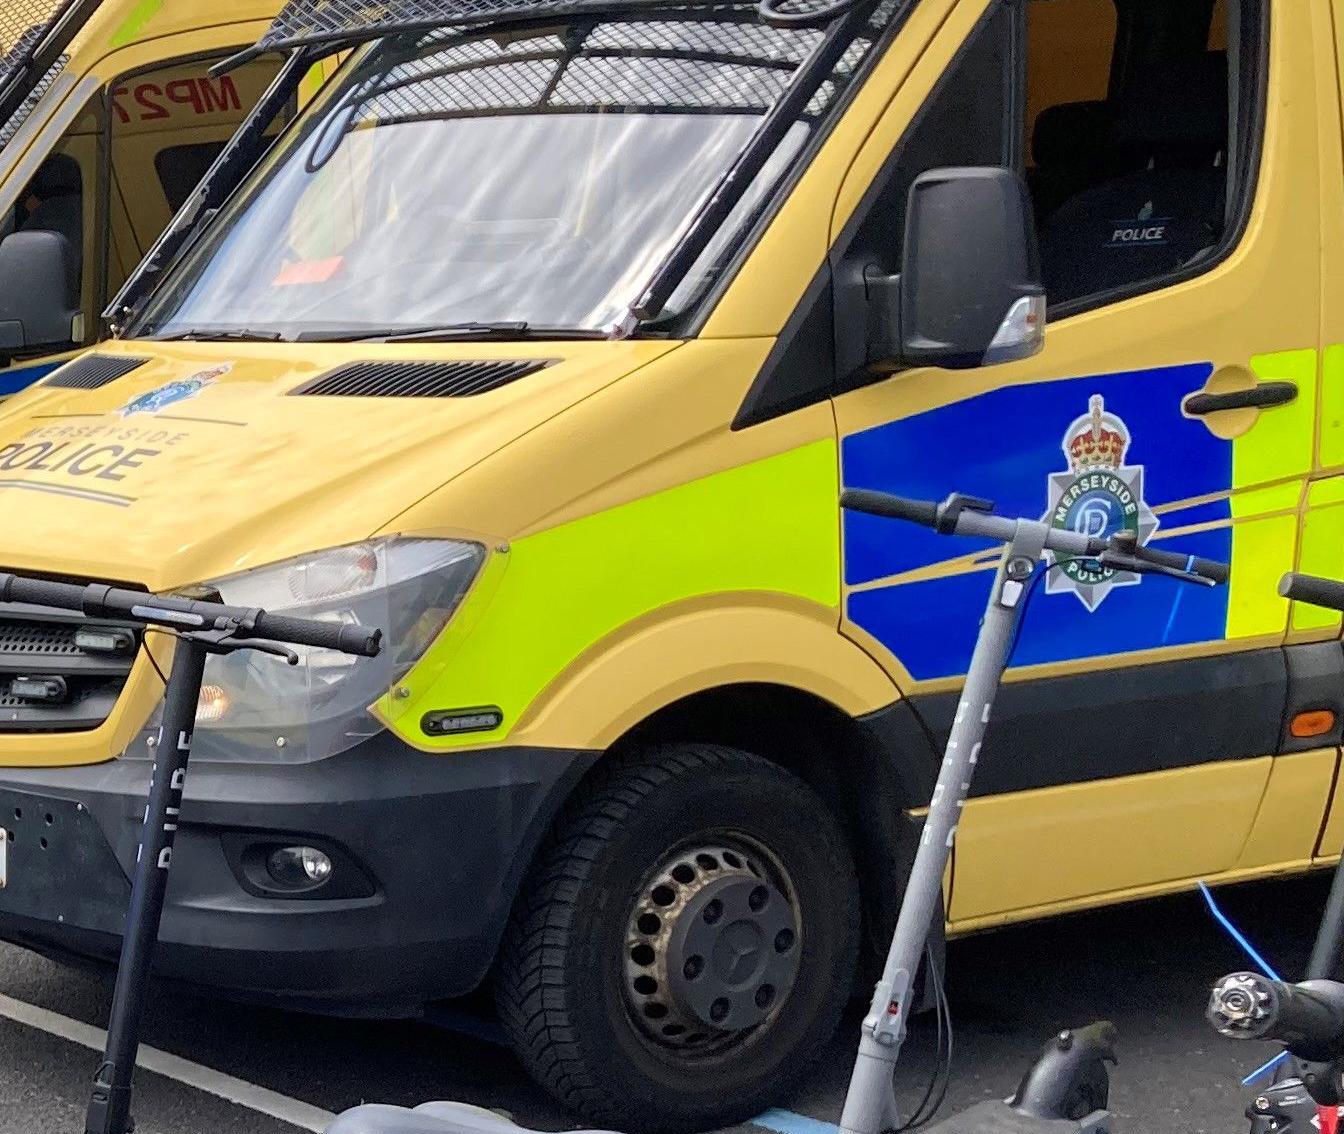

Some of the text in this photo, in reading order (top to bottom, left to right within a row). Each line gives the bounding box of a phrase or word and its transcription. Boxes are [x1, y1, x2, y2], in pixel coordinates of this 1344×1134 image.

[1112, 226, 1165, 241] POLICE
[25, 425, 190, 446] MERSEYSIDE
[1055, 474, 1137, 522] MERSEYSIDE
